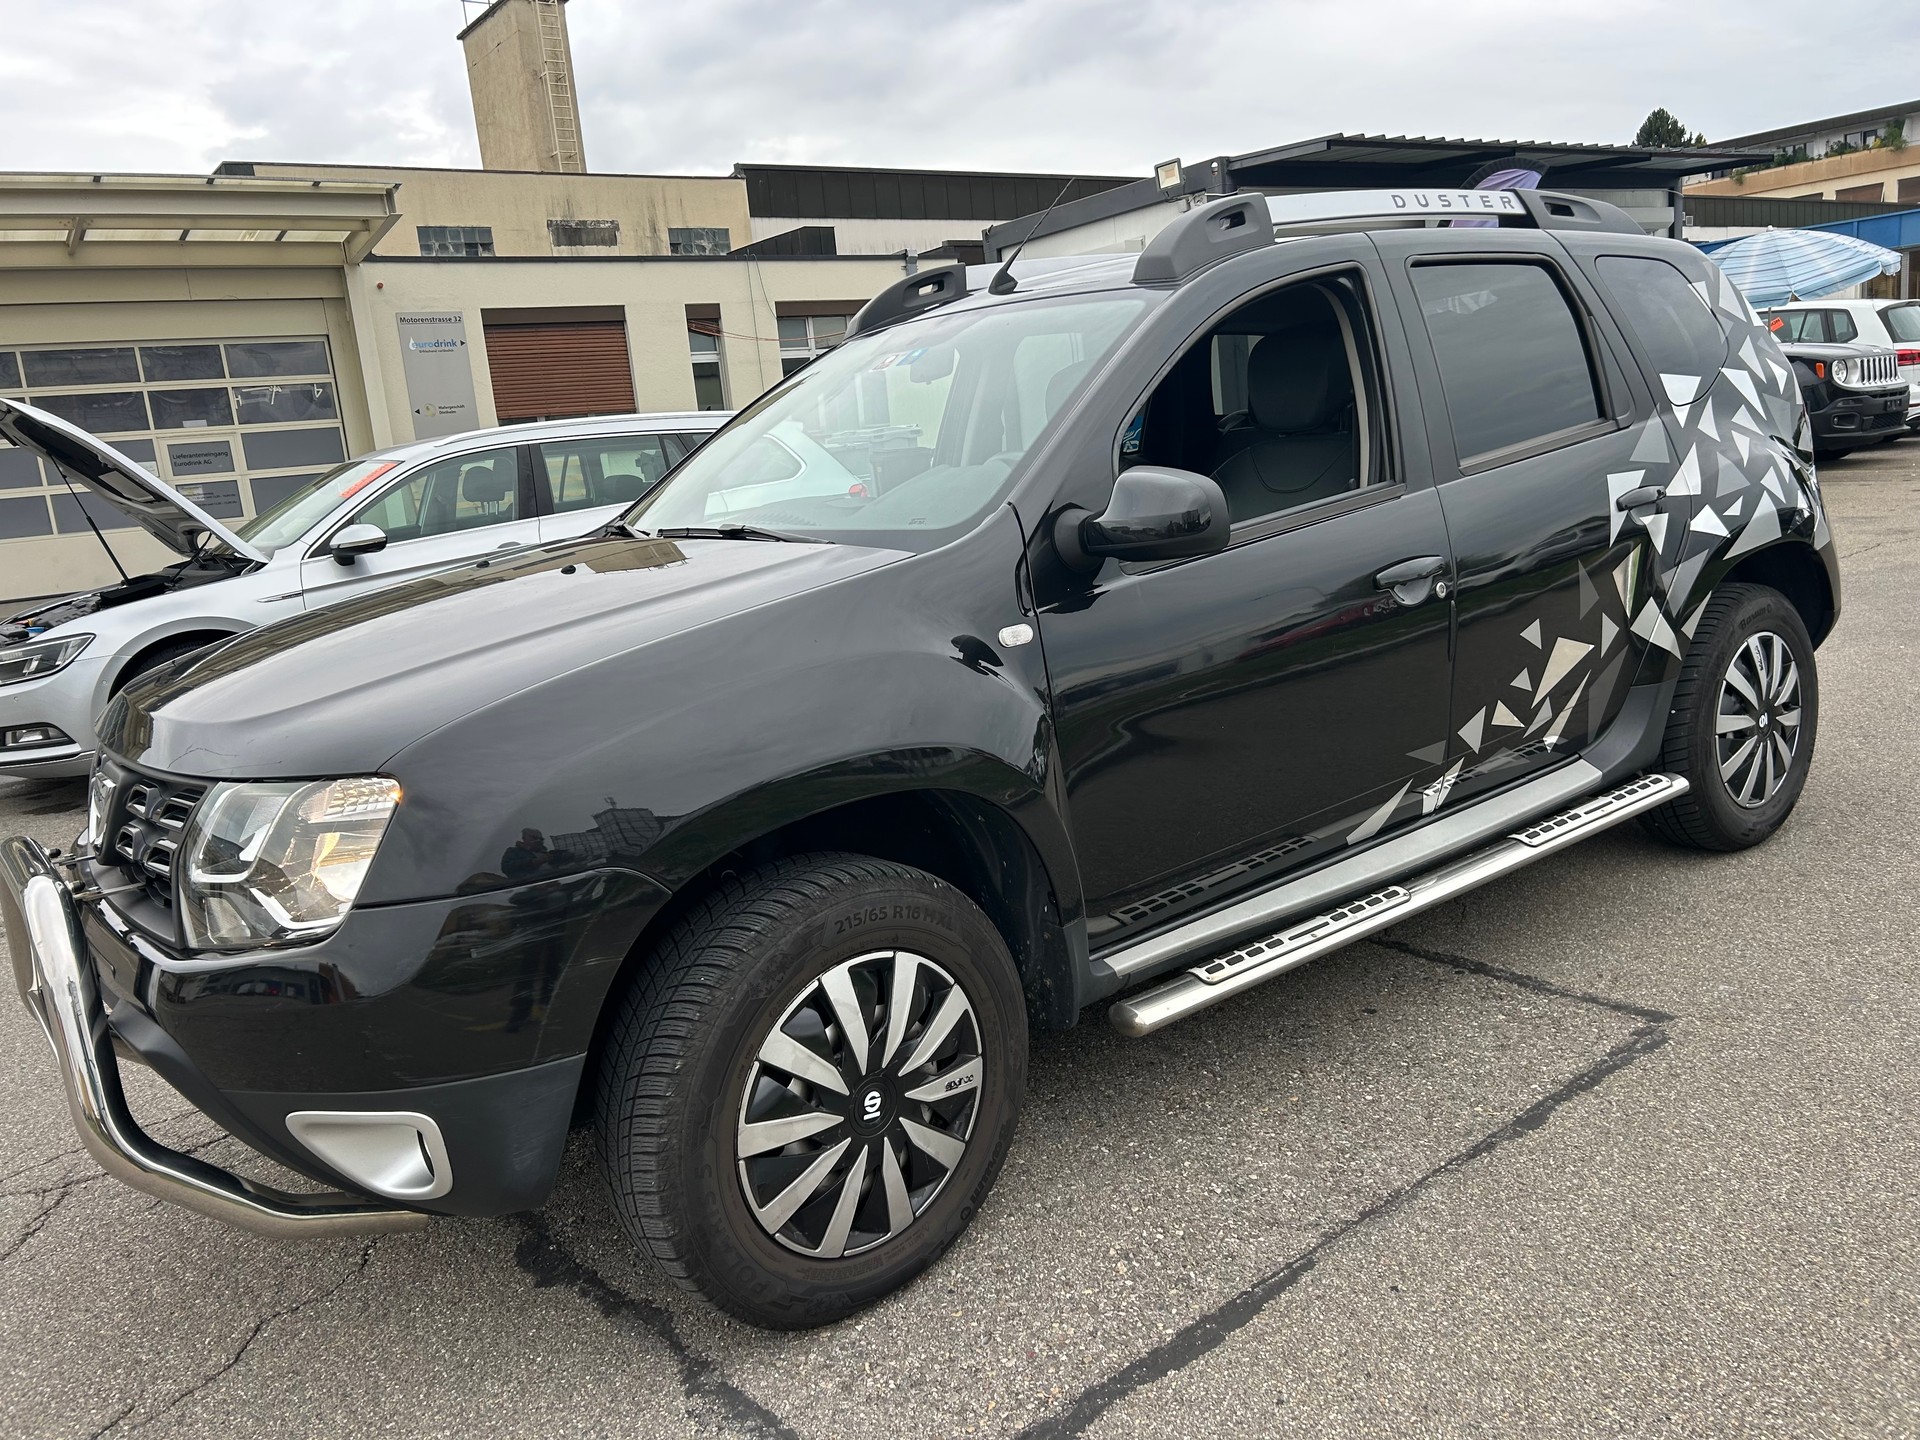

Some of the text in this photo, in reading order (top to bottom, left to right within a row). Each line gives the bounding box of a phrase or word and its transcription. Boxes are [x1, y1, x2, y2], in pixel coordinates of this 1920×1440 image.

[1390, 193, 1516, 210] DUSTER
[399, 315, 462, 324] Motorenstrasse 32
[411, 338, 458, 349] eurodrink
[172, 451, 229, 460] Lieferanteneingang
[174, 459, 202, 467] Eurodrink
[834, 906, 888, 935] 215/65
